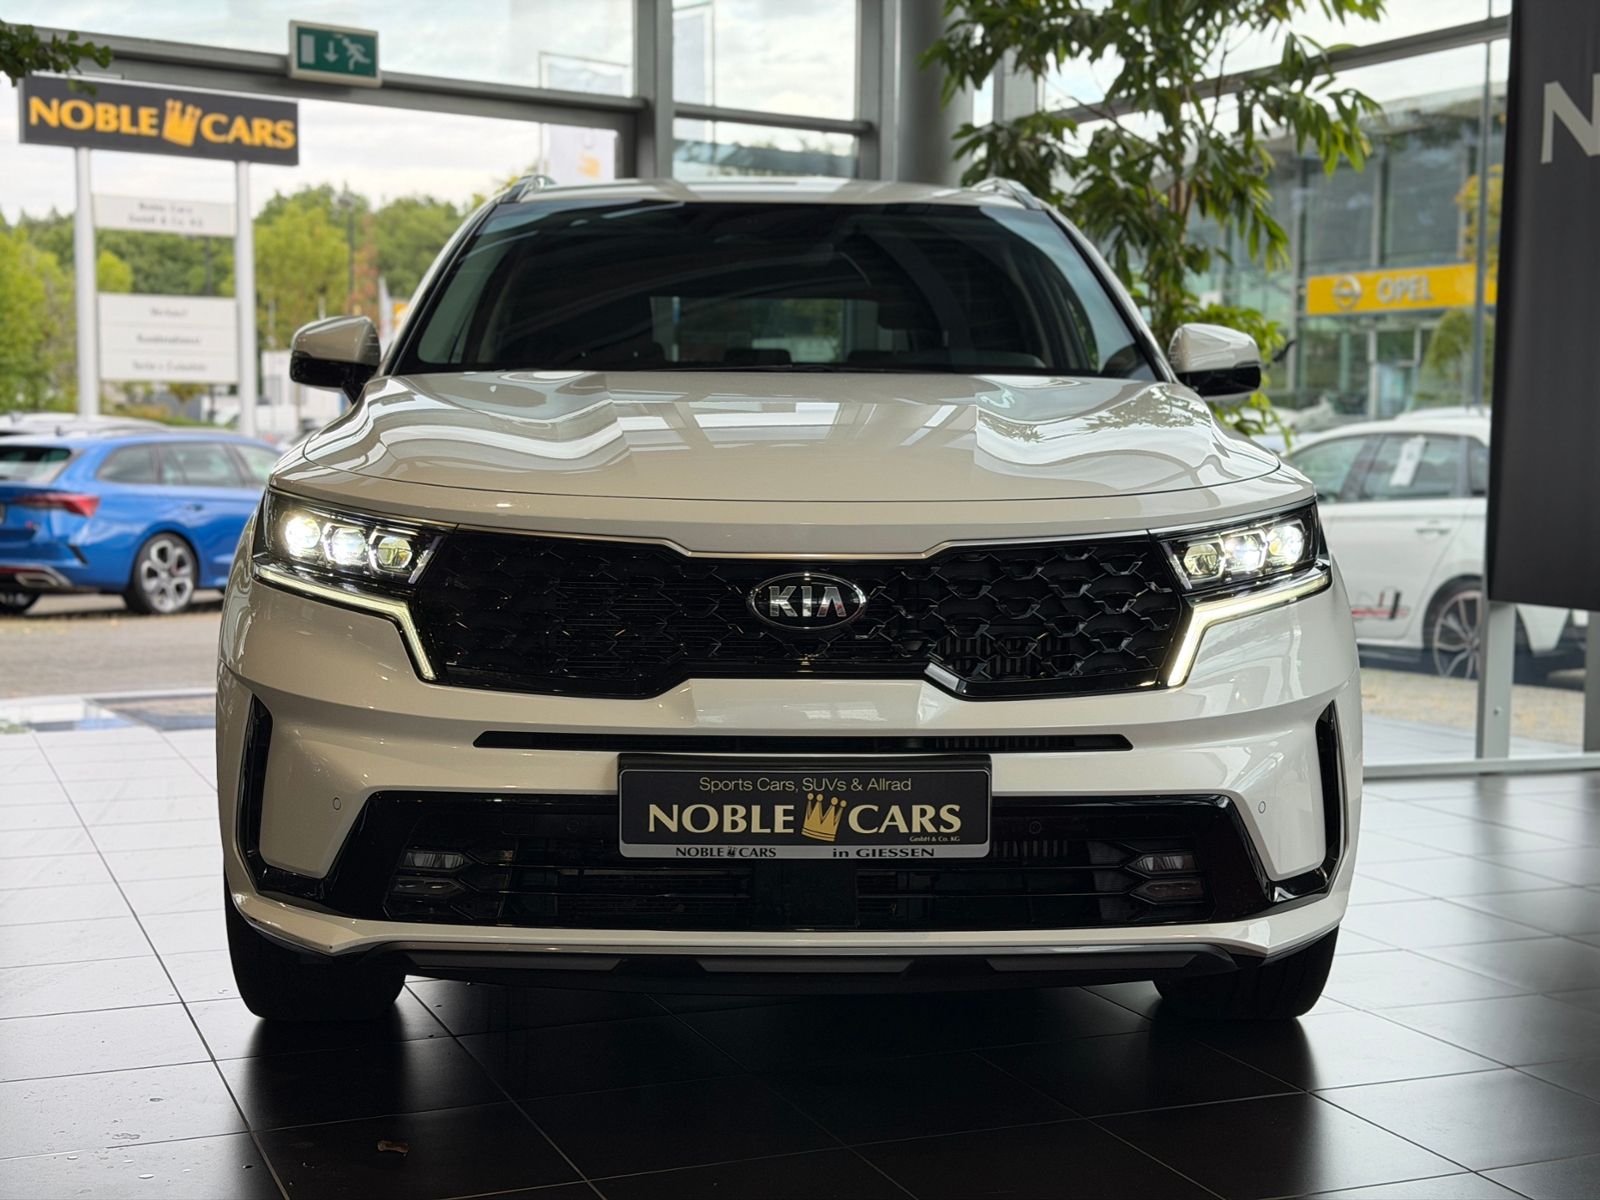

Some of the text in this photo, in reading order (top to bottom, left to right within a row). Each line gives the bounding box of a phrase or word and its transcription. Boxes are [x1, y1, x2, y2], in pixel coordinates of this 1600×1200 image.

[28, 95, 297, 149] NOBLE CARS
[1376, 274, 1433, 304] OPEL
[768, 585, 847, 617] KIA
[699, 776, 912, 794] Sports Cars, SUVs & Allrad
[648, 803, 962, 834] NOBLE CARS
[675, 847, 777, 858] NOBLE CARS
[832, 848, 935, 858] in GIESSEN
